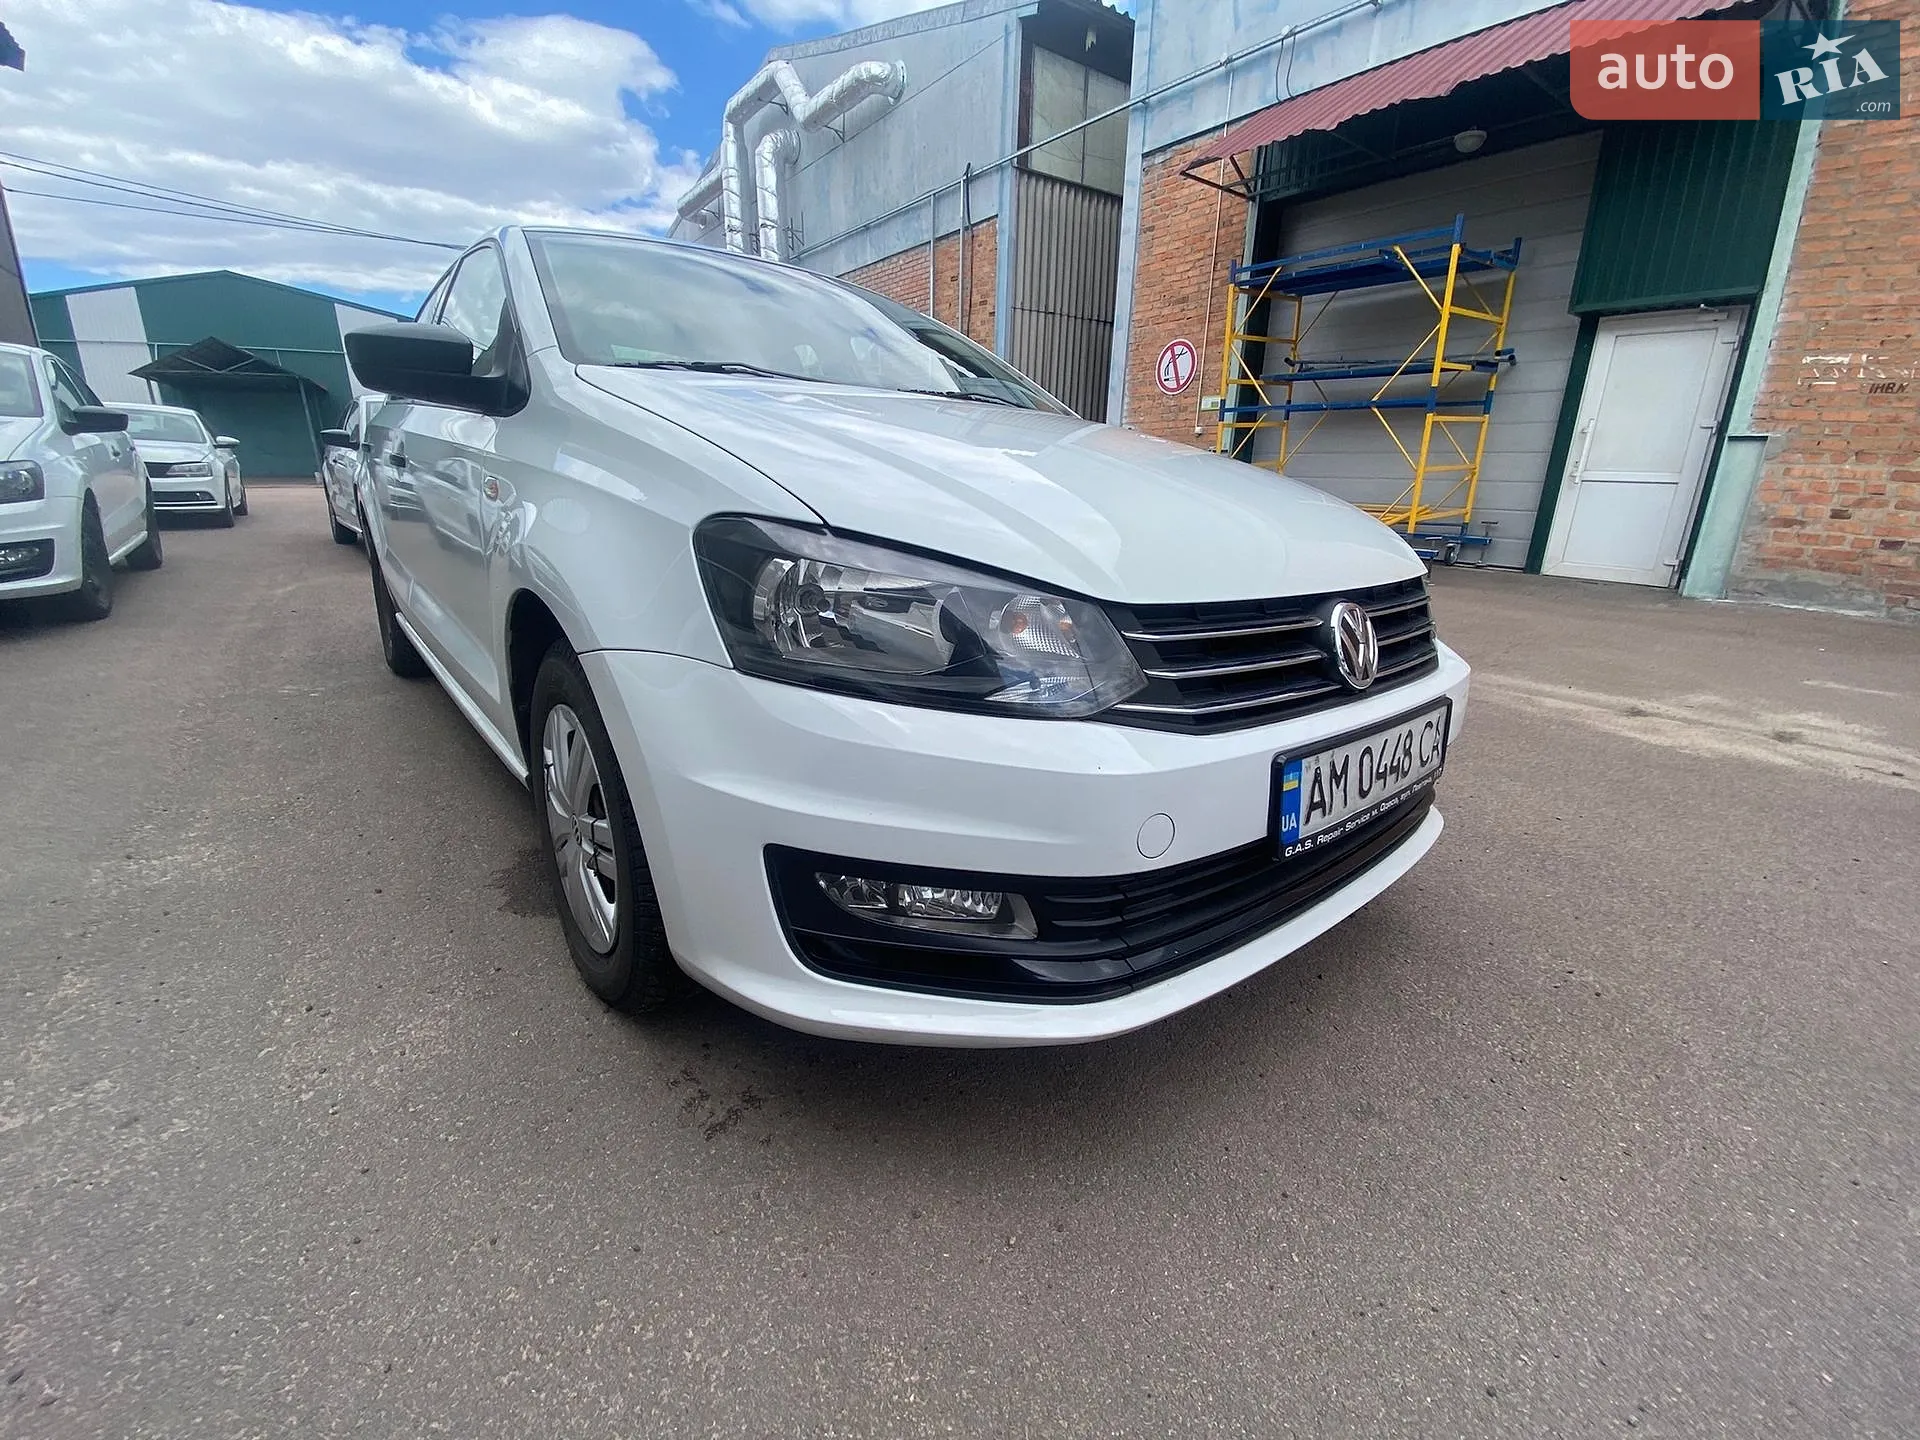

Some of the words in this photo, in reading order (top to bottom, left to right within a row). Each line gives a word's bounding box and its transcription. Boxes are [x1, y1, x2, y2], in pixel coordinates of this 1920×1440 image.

[1303, 754, 1350, 826] AM
[1358, 729, 1413, 800] 0448
[1419, 715, 1441, 768] CA
[1281, 812, 1298, 833] UA
[1284, 839, 1314, 857] G.A.S.
[1316, 827, 1344, 845] Repair
[1345, 812, 1371, 832] Service
